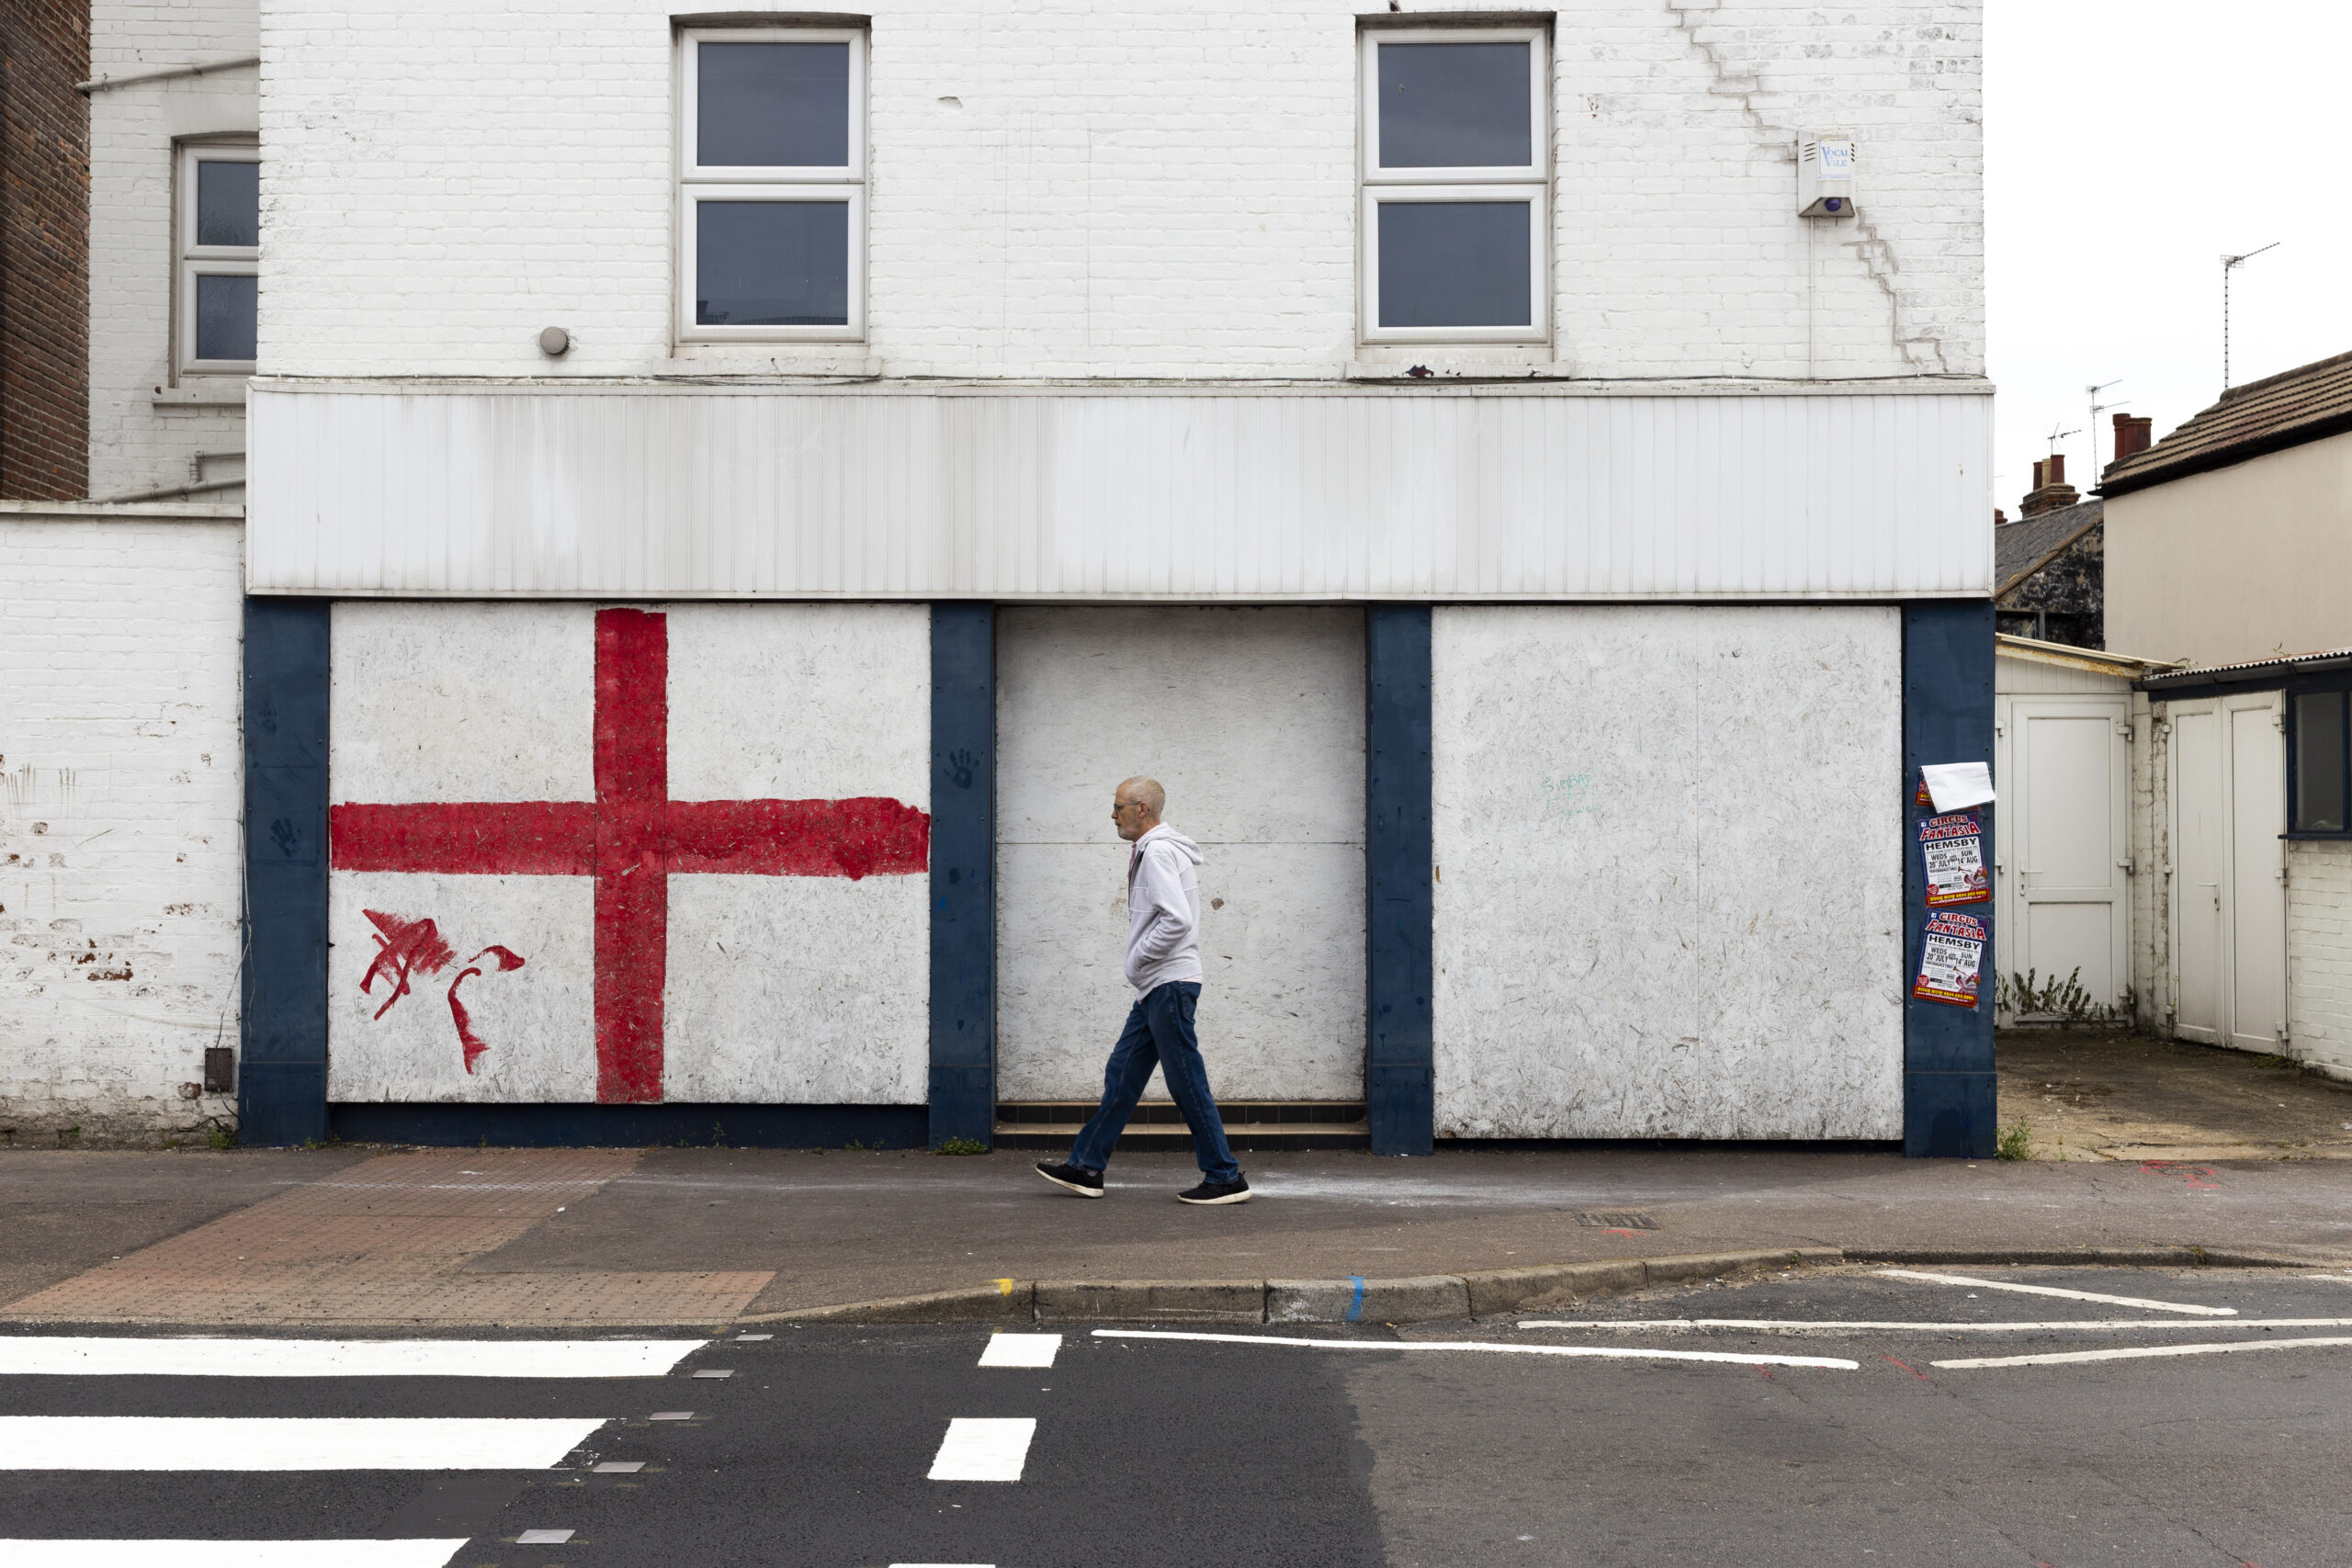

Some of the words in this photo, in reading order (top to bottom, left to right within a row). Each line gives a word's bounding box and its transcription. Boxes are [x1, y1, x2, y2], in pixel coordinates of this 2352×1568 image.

[1929, 815, 1968, 827] CIRCUS
[1919, 822, 1981, 840] FANTASIA
[1926, 838, 1977, 851] HEMSBY
[1931, 852, 1948, 861] WEDS
[1938, 859, 1951, 867] JULY
[1939, 912, 1977, 926] CIRCUS
[1925, 919, 1986, 941] FANTASIA
[1928, 934, 1981, 950] HEMSBY
[1931, 946, 1947, 954] WEDS
[1961, 952, 1973, 960] SUN
[1936, 953, 1949, 963] JULY
[1964, 959, 1976, 968] AUG
